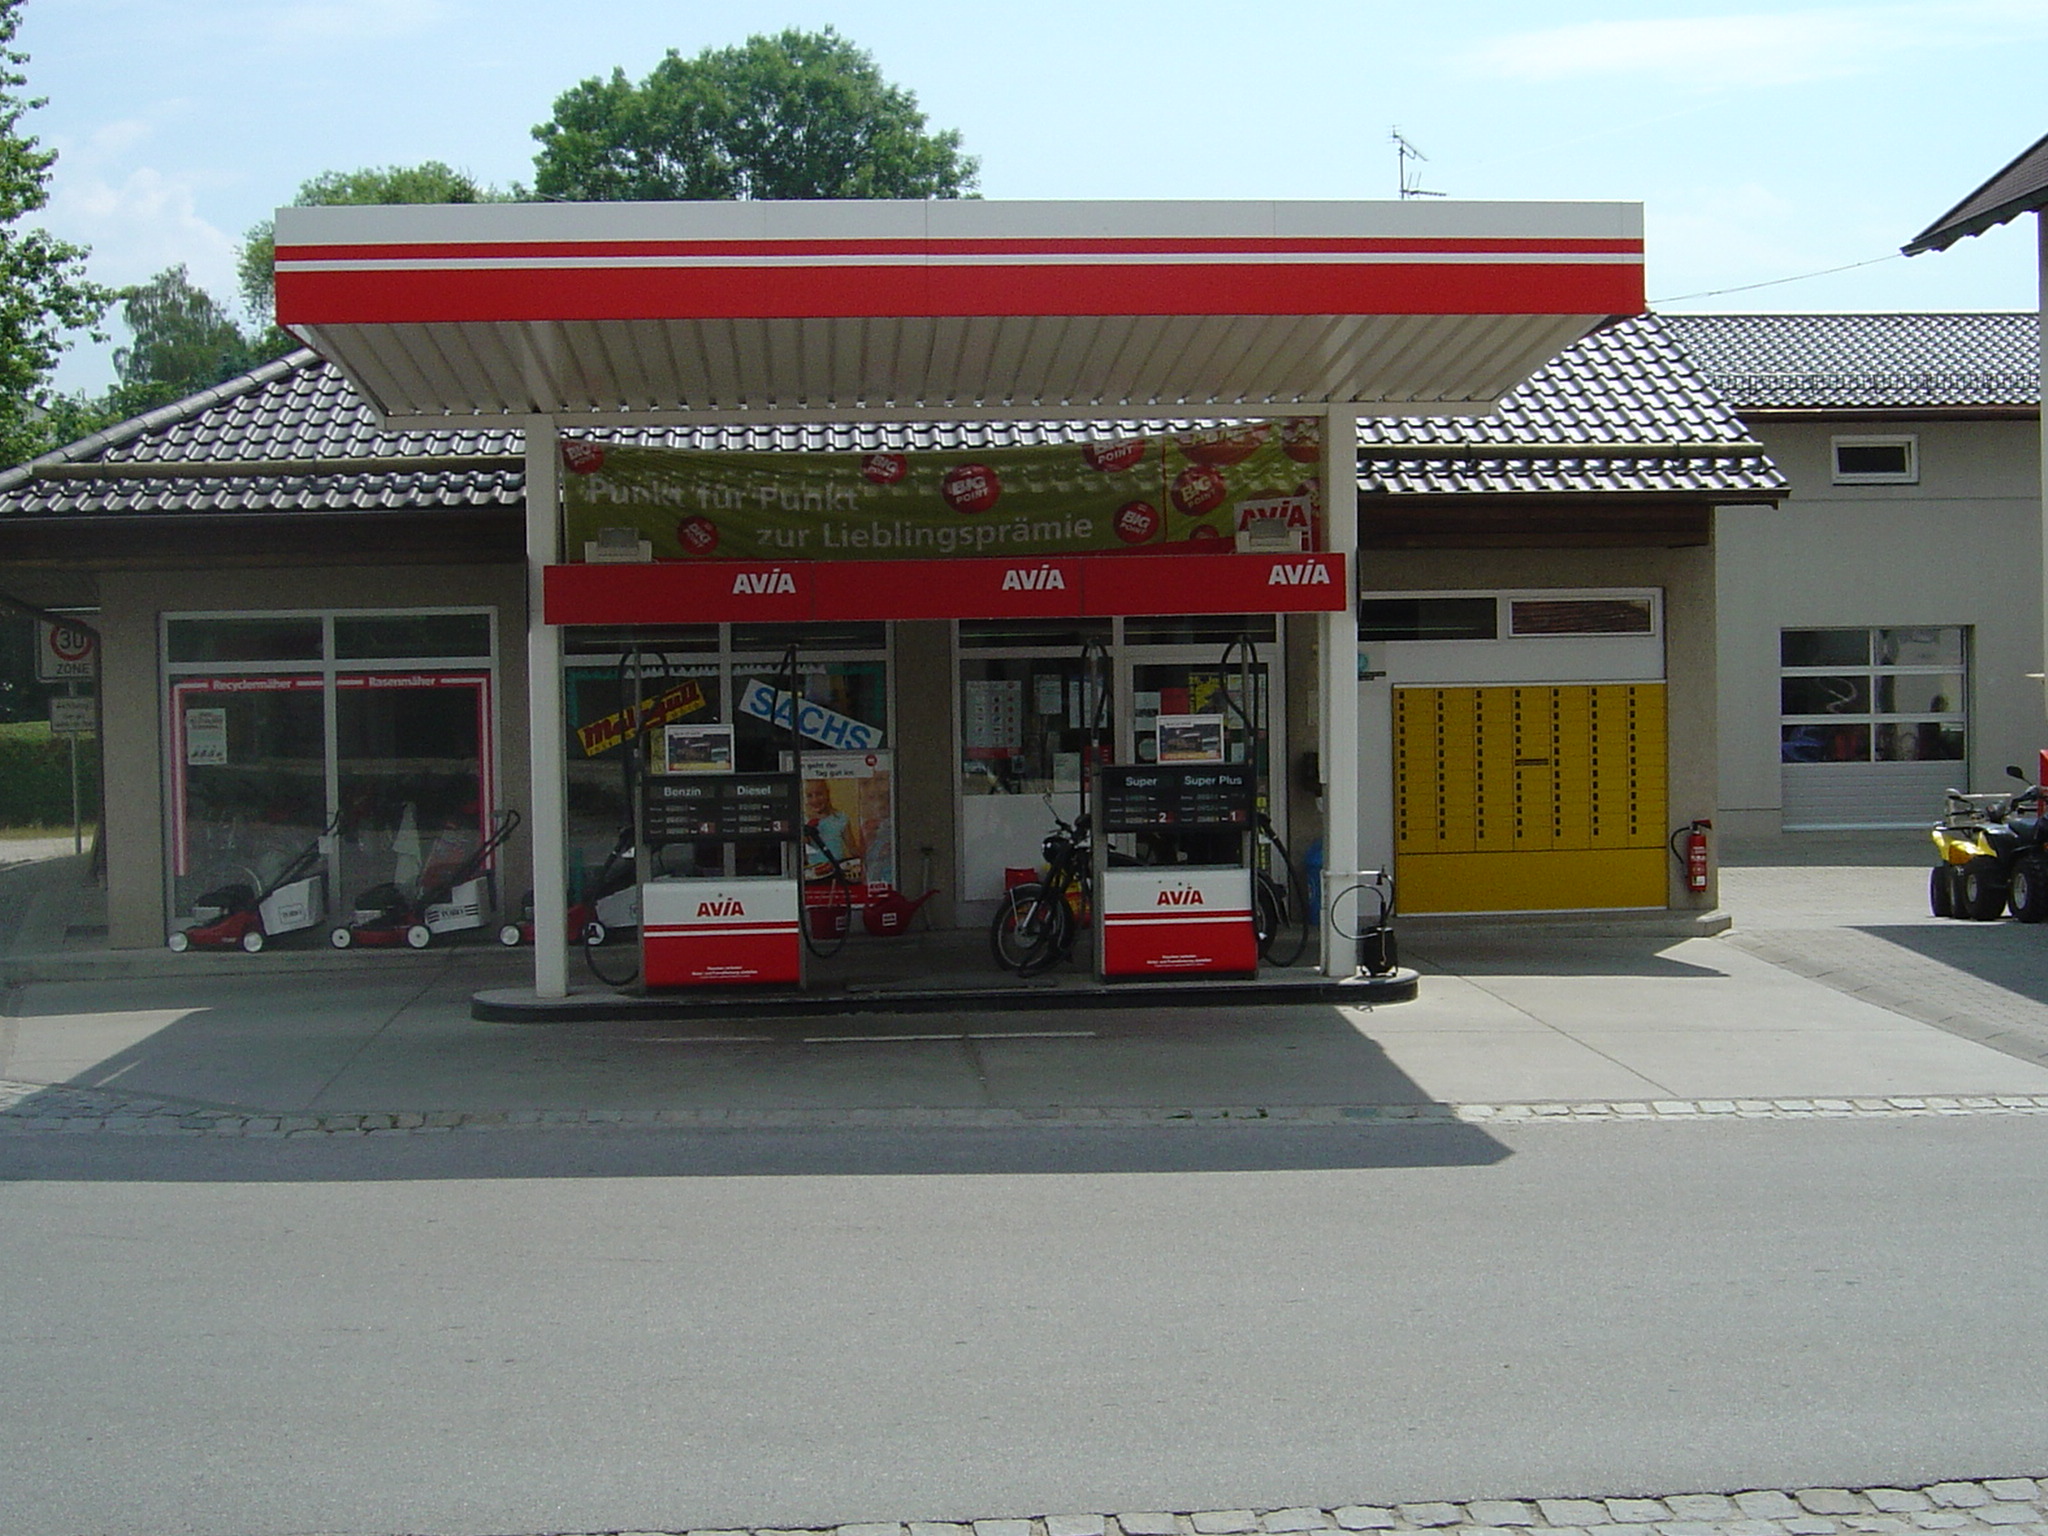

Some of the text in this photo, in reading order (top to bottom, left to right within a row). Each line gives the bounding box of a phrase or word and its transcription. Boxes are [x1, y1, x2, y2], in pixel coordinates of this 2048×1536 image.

[871, 454, 899, 475] BIG
[1097, 446, 1133, 465] POINT
[585, 476, 860, 512] Punkt für Punkt
[951, 475, 987, 496] BIG
[1182, 476, 1212, 502] BIG
[955, 488, 989, 504] POINT
[1187, 487, 1217, 509] POINT
[1122, 510, 1151, 531] BIG
[757, 514, 1094, 553] zur Lieblingsprämie
[732, 568, 796, 595] AVIA
[1002, 564, 1065, 590] AVIA
[1268, 559, 1330, 585] AVIA
[59, 630, 85, 650] 30
[56, 663, 91, 675] ZONE
[368, 676, 436, 688] Rasenmäher
[750, 687, 871, 750] SACHS
[736, 785, 772, 796] Diesel
[1125, 776, 1158, 788] Super
[1184, 775, 1243, 787] Super Plus
[663, 787, 702, 797] Benzin
[773, 820, 782, 832] 3
[1158, 812, 1167, 823] 2
[1230, 811, 1236, 821] 1
[700, 823, 709, 833] 4
[1157, 886, 1204, 906] AVIA
[697, 897, 745, 917] AVIA
